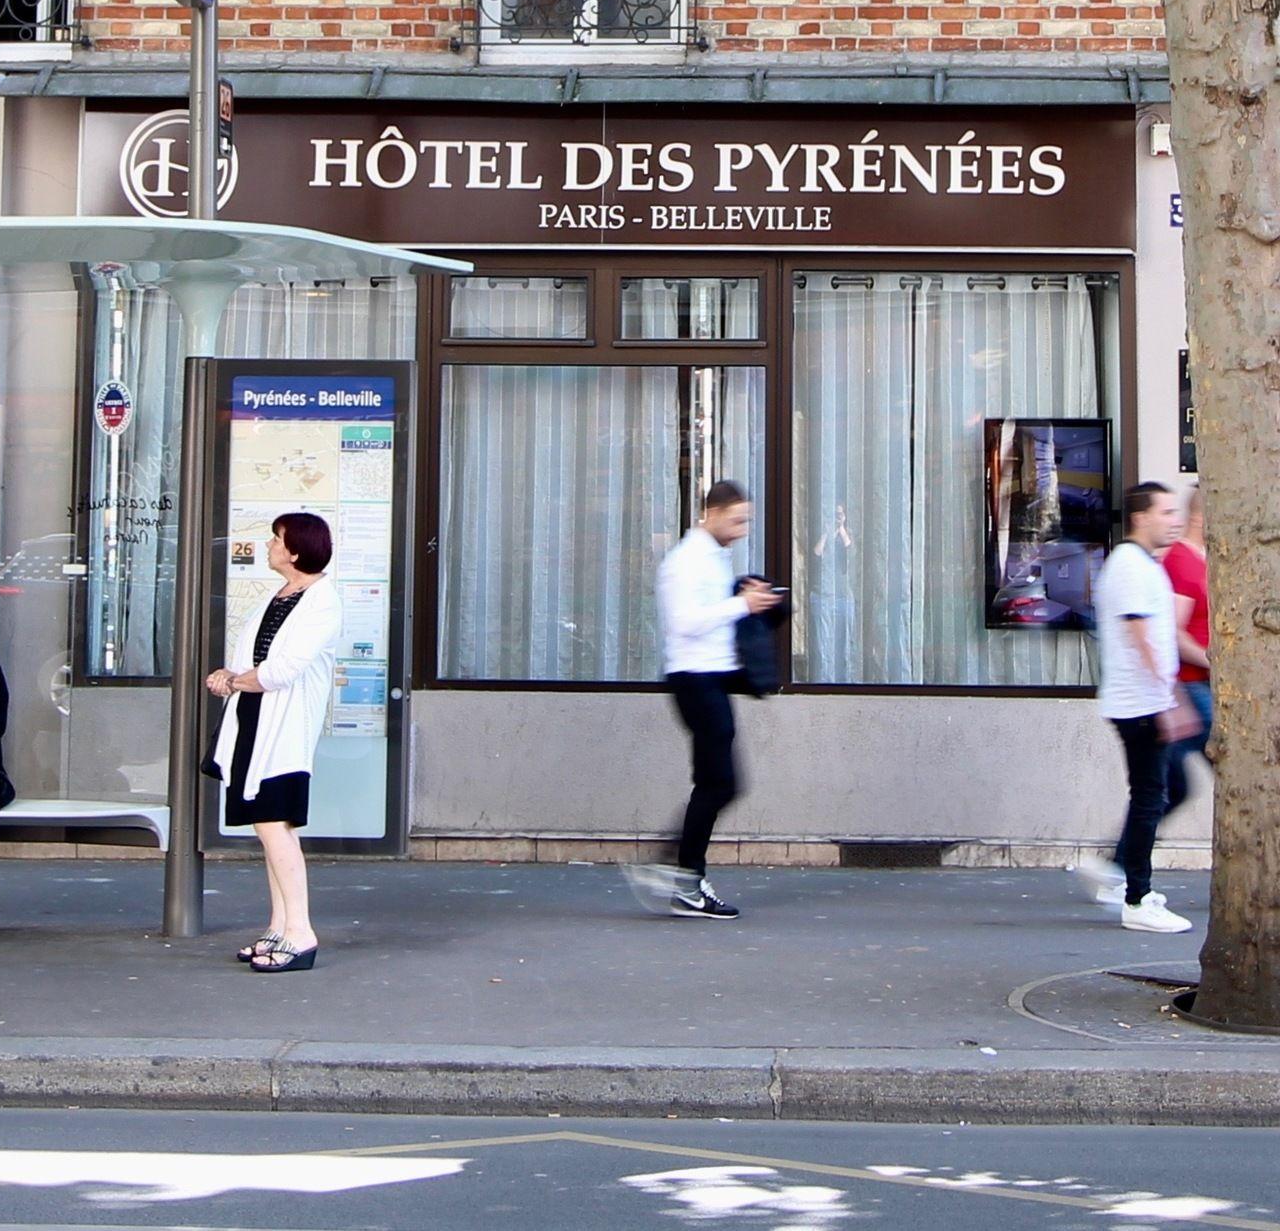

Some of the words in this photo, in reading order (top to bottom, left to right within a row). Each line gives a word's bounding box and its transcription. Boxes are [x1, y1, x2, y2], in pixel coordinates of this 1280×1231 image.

[308, 125, 542, 189] HÔTEL
[561, 142, 695, 193] DES
[713, 129, 1066, 196] PYRÉNÉES
[538, 204, 626, 229] PARIS
[650, 205, 832, 231] BELLEVILLE
[244, 390, 306, 409] Pyrénées
[318, 391, 381, 407] Belleville
[234, 543, 252, 556] 26
